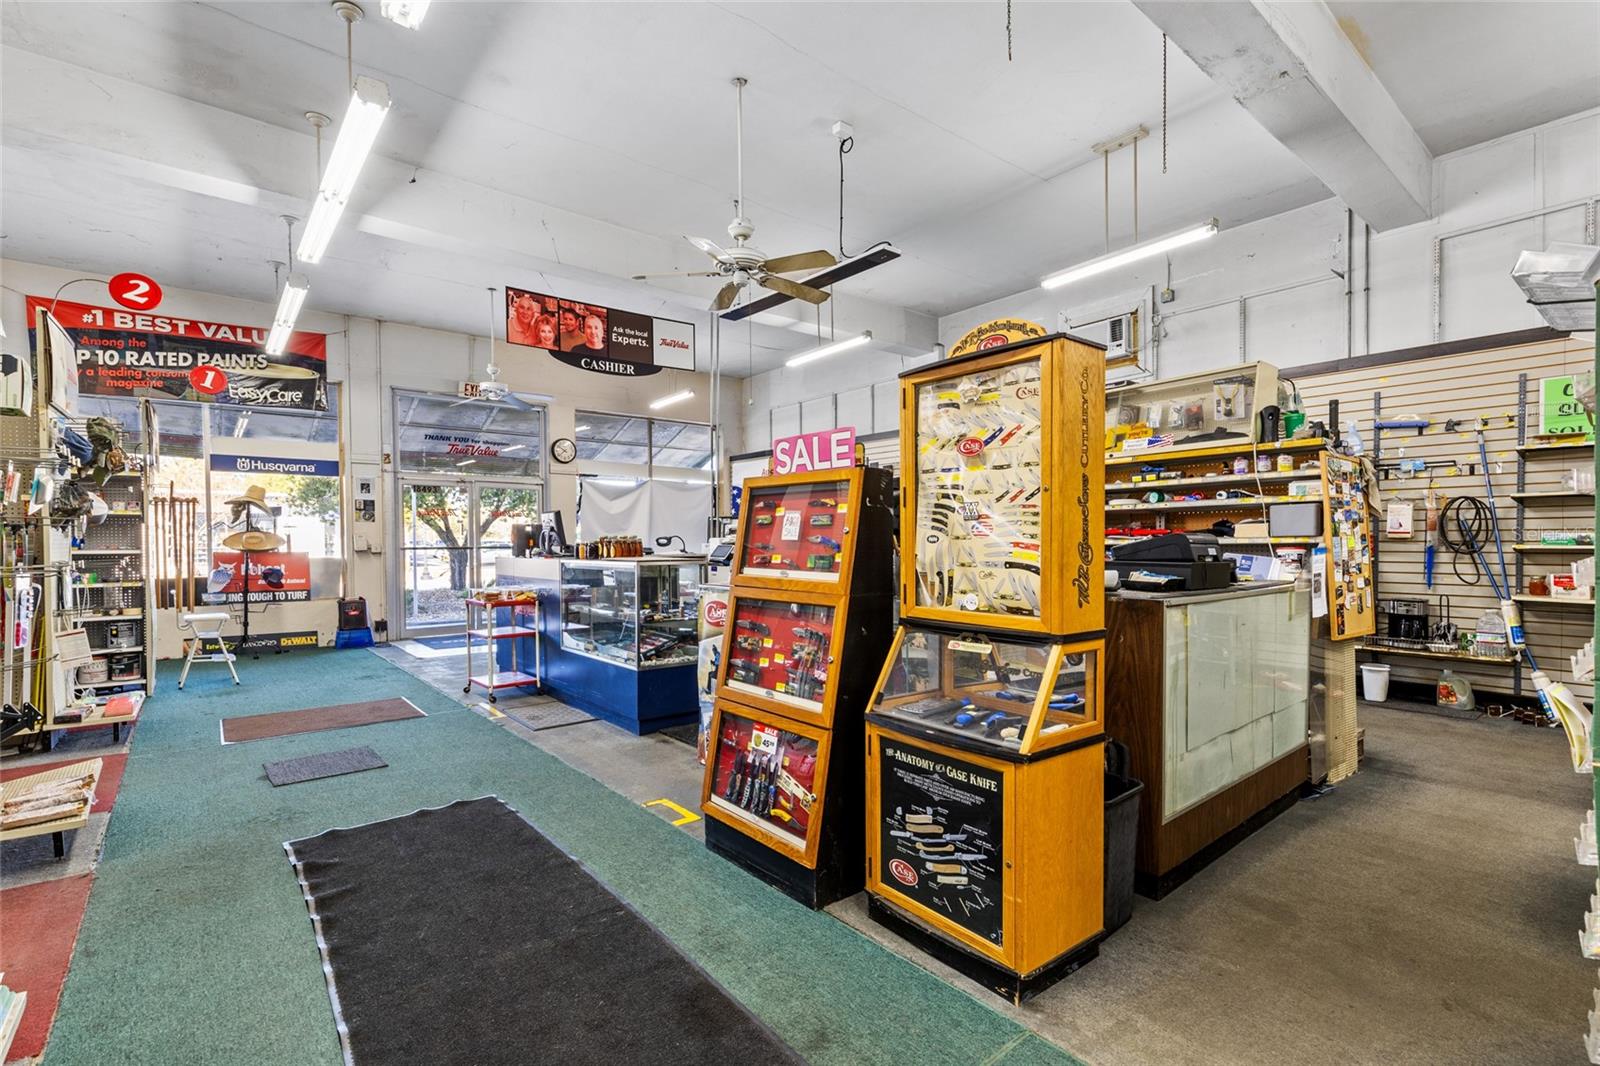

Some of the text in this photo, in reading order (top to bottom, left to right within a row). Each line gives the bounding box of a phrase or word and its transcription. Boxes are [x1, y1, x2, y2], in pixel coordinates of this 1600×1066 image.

[122, 280, 150, 304] 2
[82, 309, 269, 345] #1 BEST VALU
[612, 326, 624, 334] Ask
[635, 329, 648, 337] local
[80, 335, 147, 349] Among the
[611, 333, 649, 347] Experts.
[95, 349, 120, 366] 10
[125, 350, 193, 367] RATED
[197, 352, 268, 369] PAINTS
[86, 368, 95, 376] a
[98, 366, 143, 379] leading
[145, 369, 191, 378] consum
[581, 358, 635, 375] CASHIER
[106, 379, 164, 390] magazine
[200, 370, 216, 389] 1
[228, 382, 303, 404] EasyCare
[464, 383, 483, 397] EXI
[424, 433, 452, 442] THANK
[775, 431, 851, 475] SALE
[251, 460, 316, 473] Husqvarna
[274, 591, 285, 601] TO
[286, 591, 308, 600] TURF
[895, 750, 935, 772] ANATOMY
[946, 766, 968, 782] CASE
[969, 773, 998, 792] KNIFE
